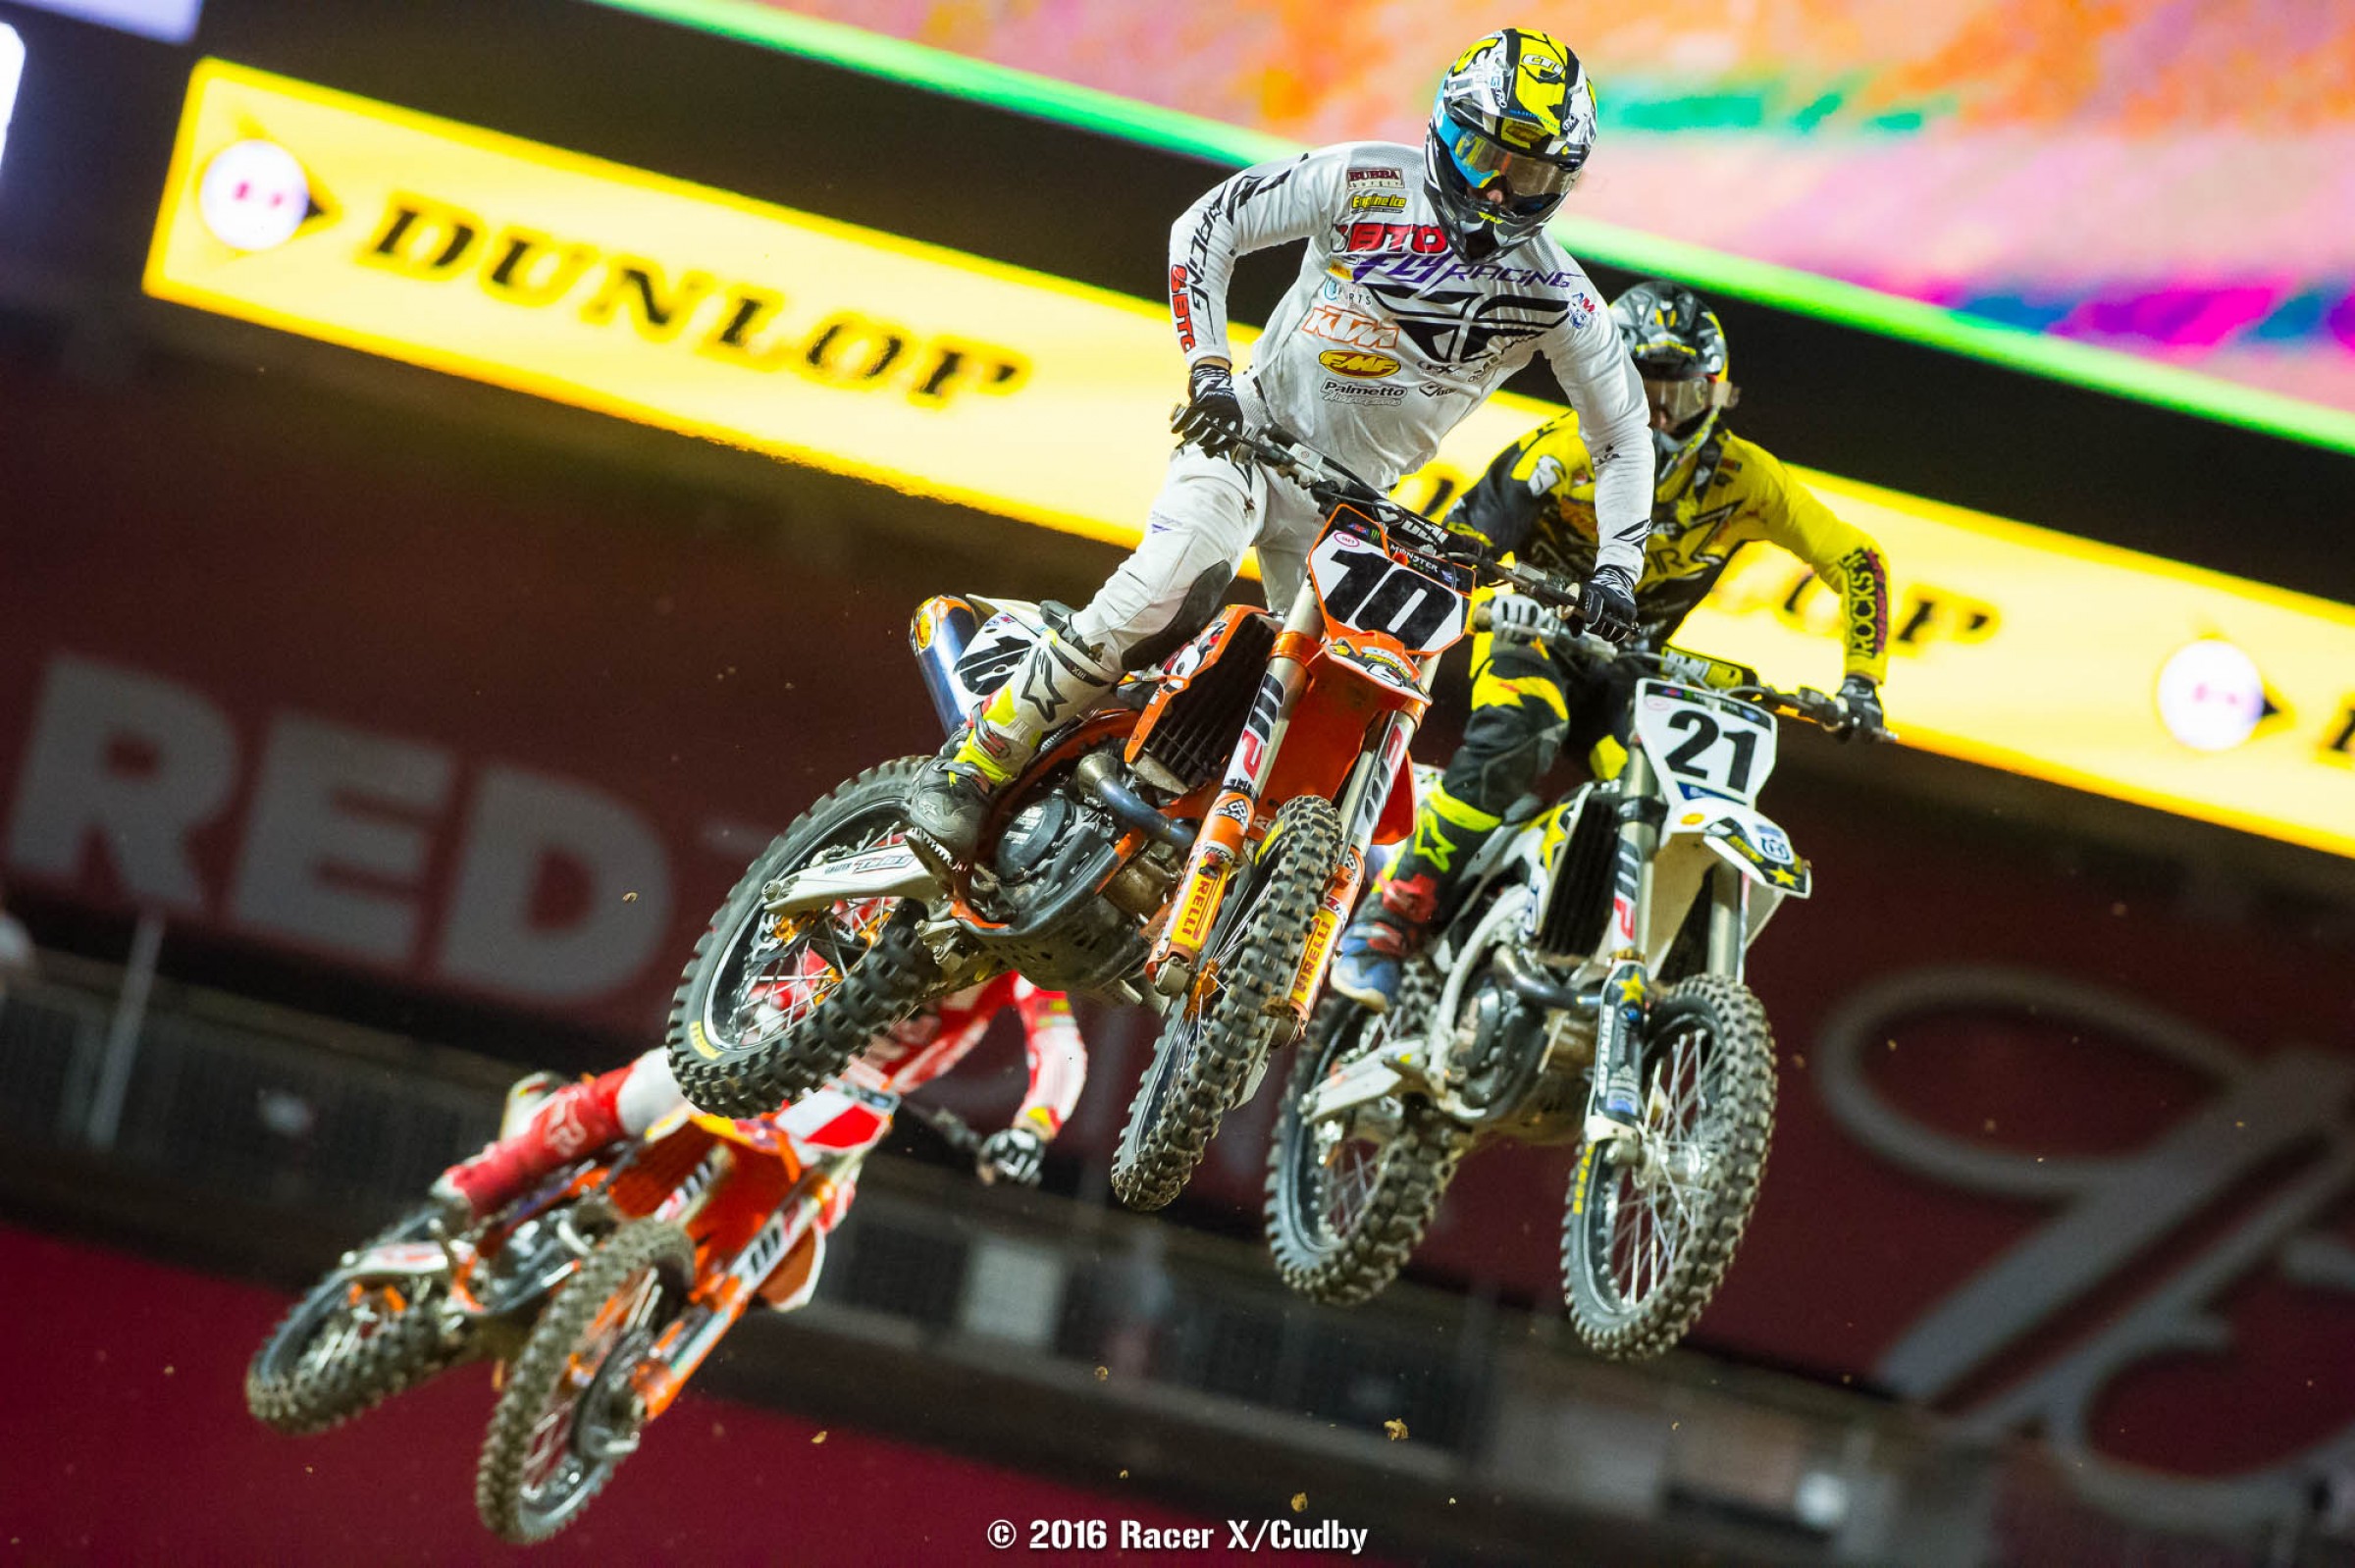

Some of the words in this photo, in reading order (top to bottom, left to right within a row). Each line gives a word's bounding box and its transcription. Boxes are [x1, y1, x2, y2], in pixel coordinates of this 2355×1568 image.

[359, 192, 1028, 405] DUNLOP
[1352, 250, 1455, 284] FLY
[1301, 305, 1400, 349] KTM
[1321, 352, 1398, 373] FMF
[1325, 380, 1407, 396] Palmetto
[1325, 549, 1458, 650] 10
[1665, 709, 1758, 794] 21
[4, 648, 675, 1001] RED
